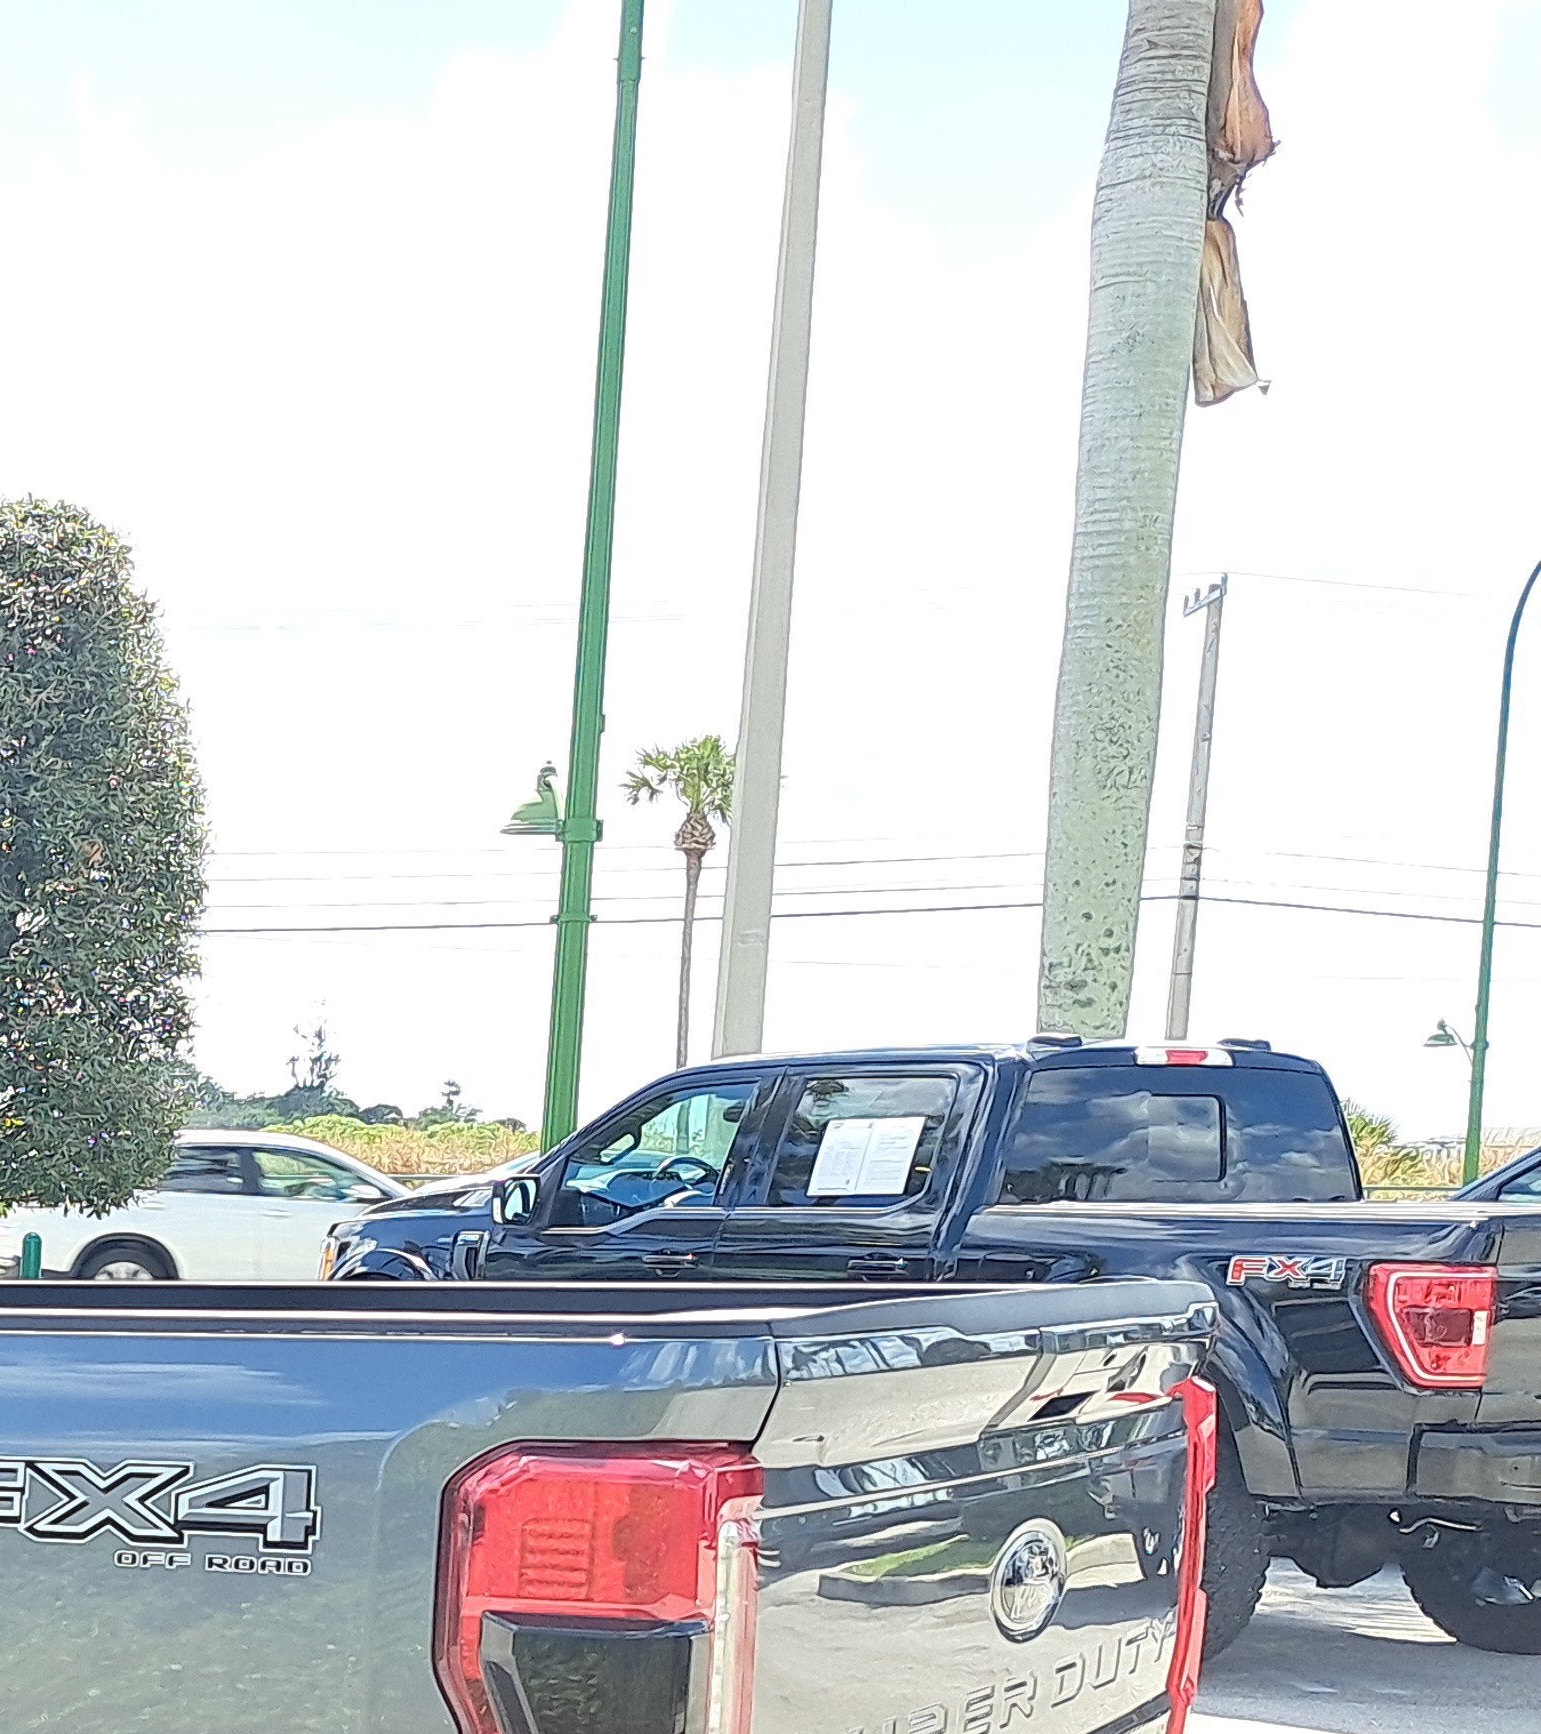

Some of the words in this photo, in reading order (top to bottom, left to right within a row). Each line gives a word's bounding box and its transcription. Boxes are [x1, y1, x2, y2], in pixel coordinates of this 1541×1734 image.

[1226, 1254, 1348, 1286] FX4
[113, 1549, 193, 1569] OFF
[204, 1552, 313, 1576] ROAD
[1049, 1612, 1178, 1709] DUTY
